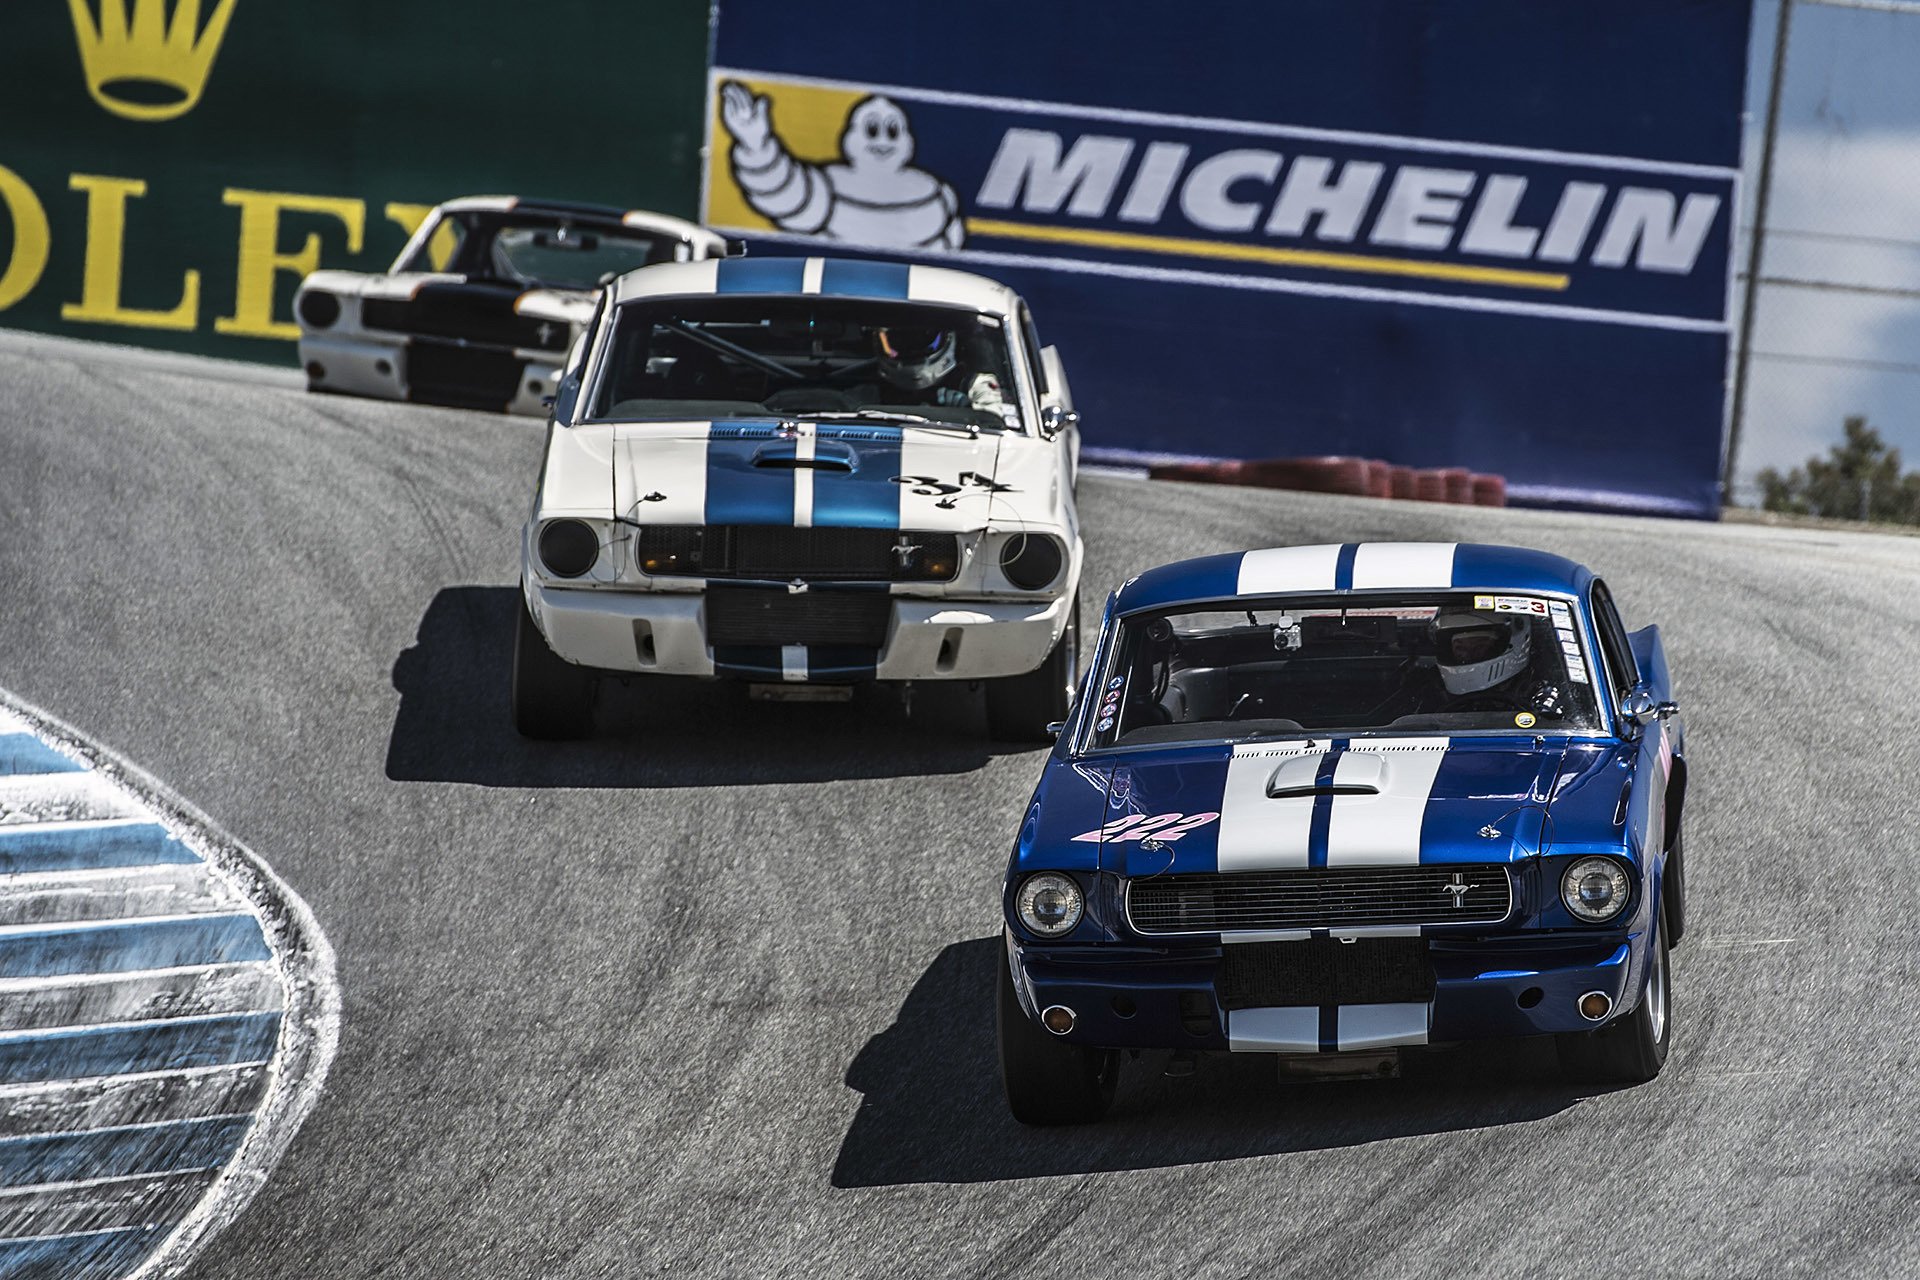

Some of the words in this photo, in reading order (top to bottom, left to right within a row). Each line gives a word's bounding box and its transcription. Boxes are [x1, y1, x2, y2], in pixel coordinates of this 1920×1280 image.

[976, 127, 1721, 275] MICHELIN
[888, 471, 1024, 495] 34
[1531, 601, 1546, 614] 3
[1071, 812, 1220, 843] 222
